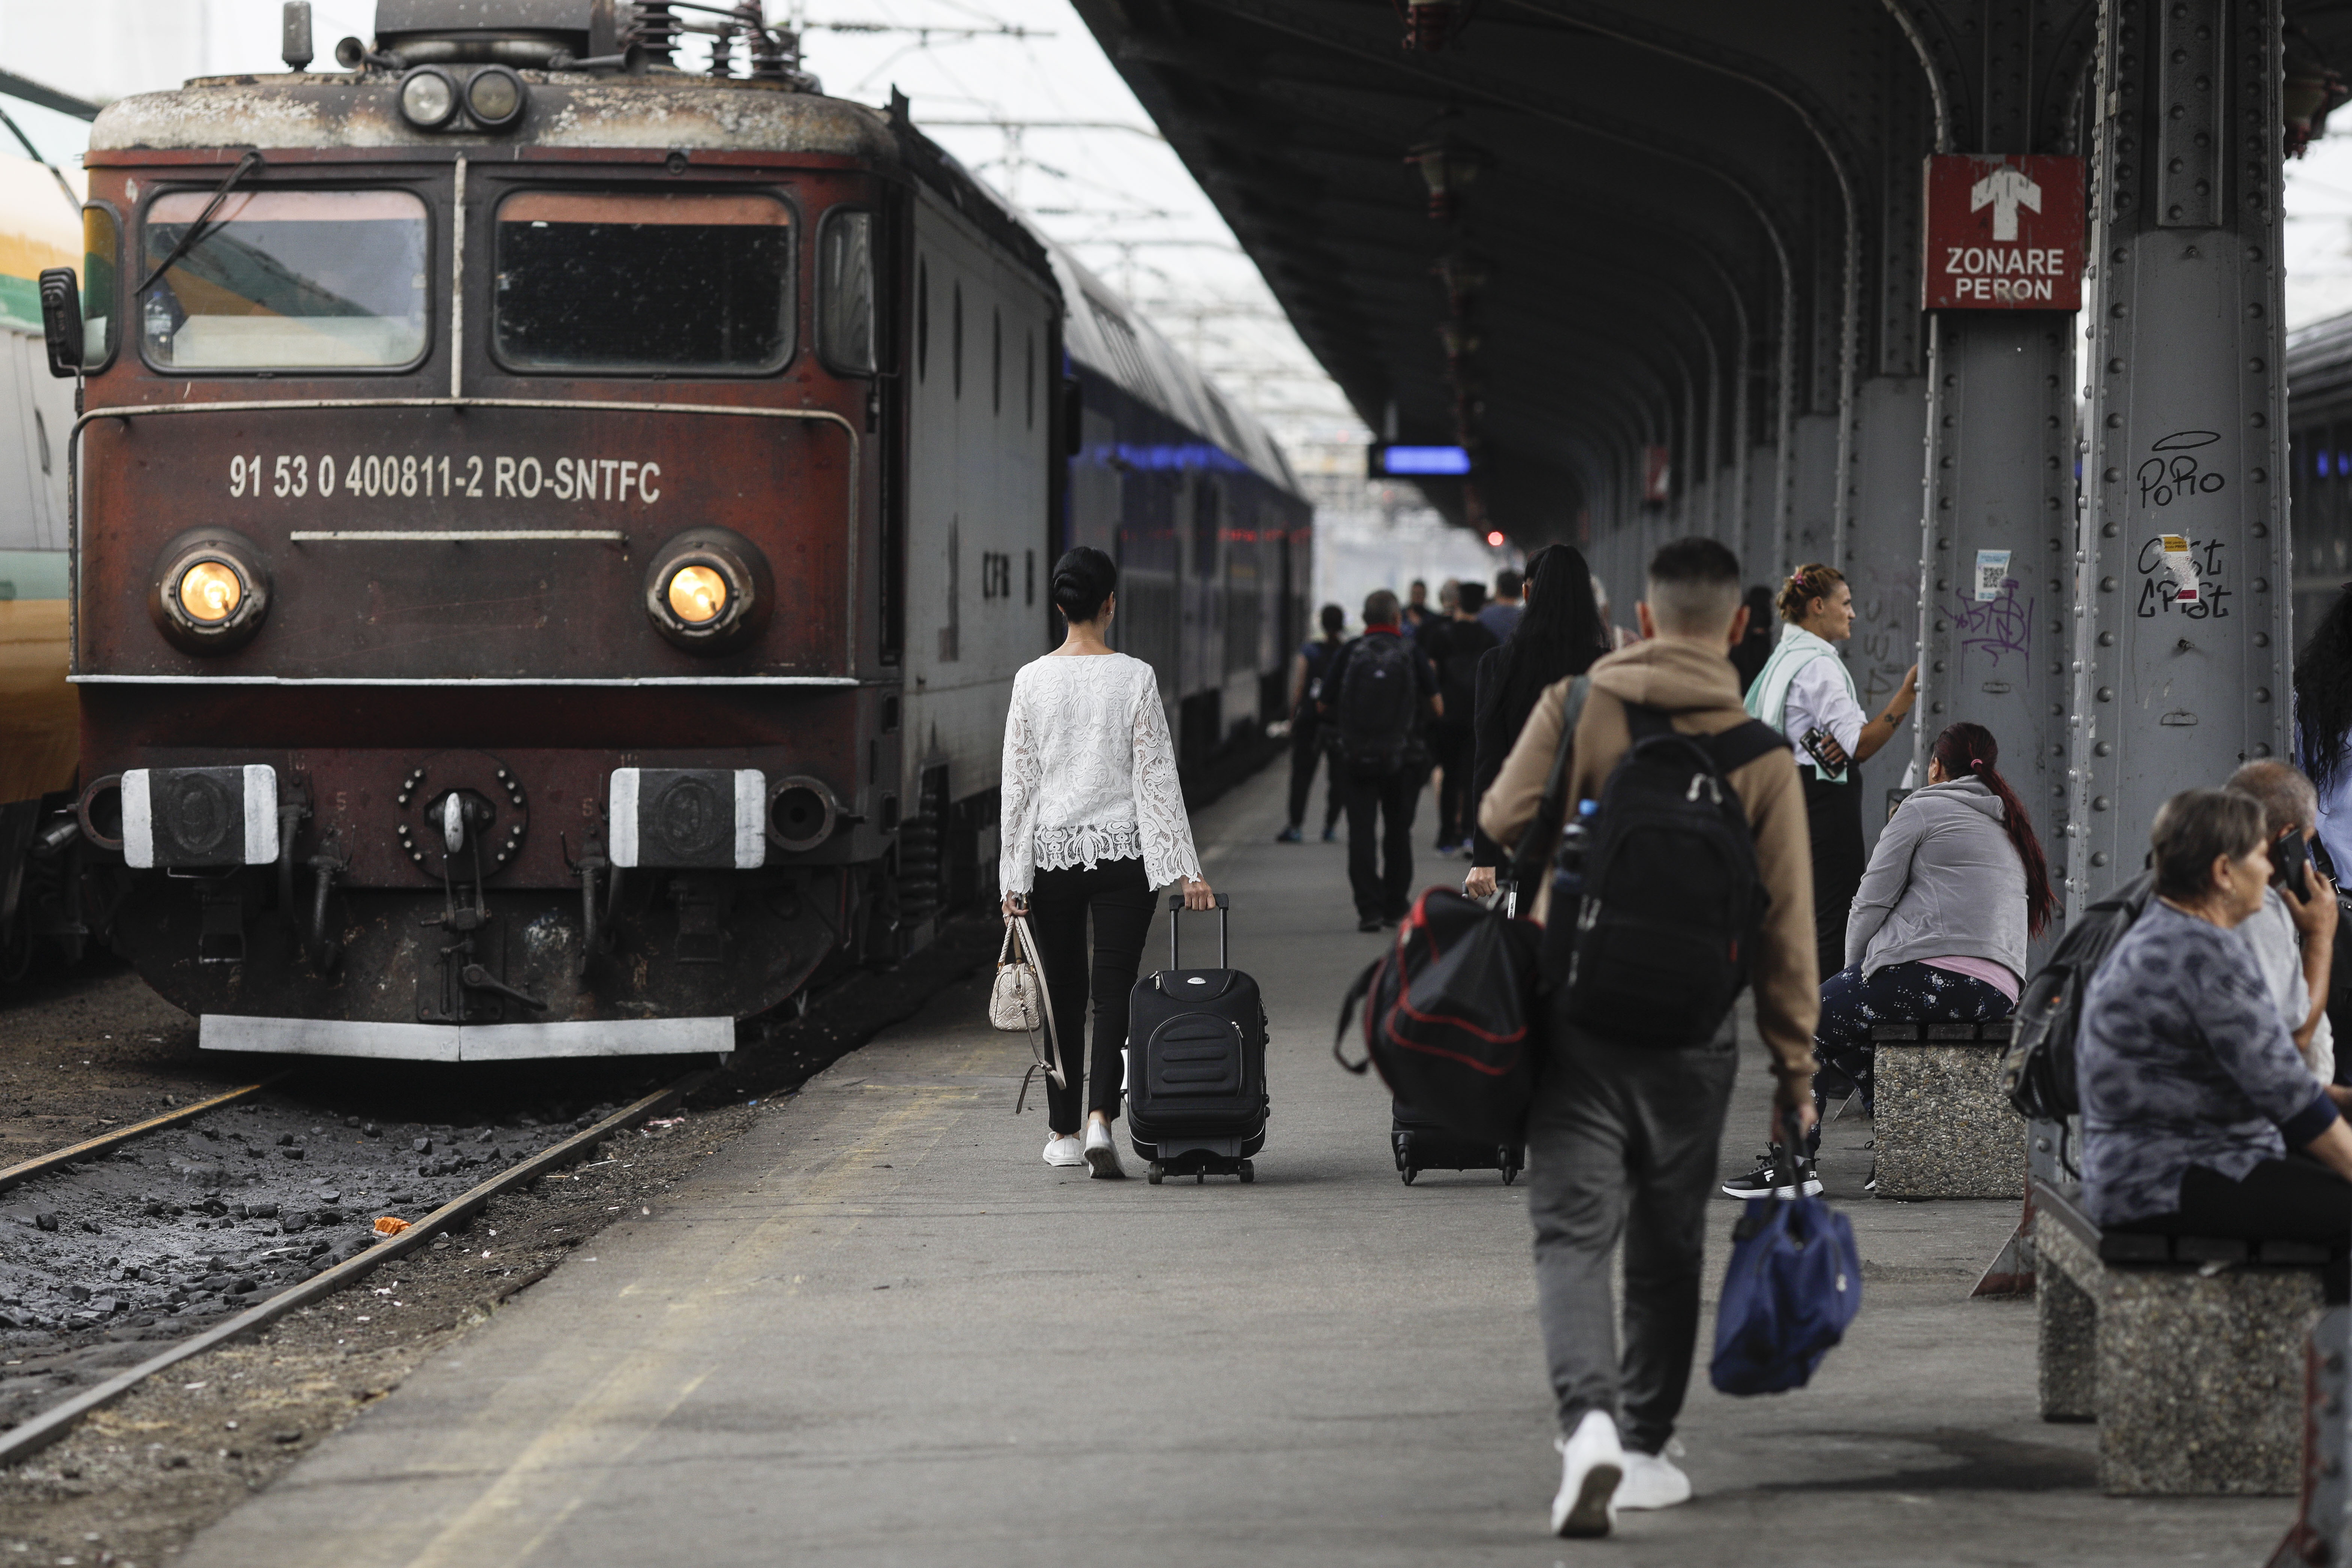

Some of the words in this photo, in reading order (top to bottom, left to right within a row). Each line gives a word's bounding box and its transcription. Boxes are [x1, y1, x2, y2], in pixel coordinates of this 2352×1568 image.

[1946, 247, 2064, 275] ZONARE
[1955, 277, 2053, 301] PERON
[229, 454, 261, 498] 91
[273, 455, 308, 498] 53
[318, 455, 336, 498] 0
[345, 454, 483, 498] 400811-2
[495, 456, 662, 504] RO-SNTFC
